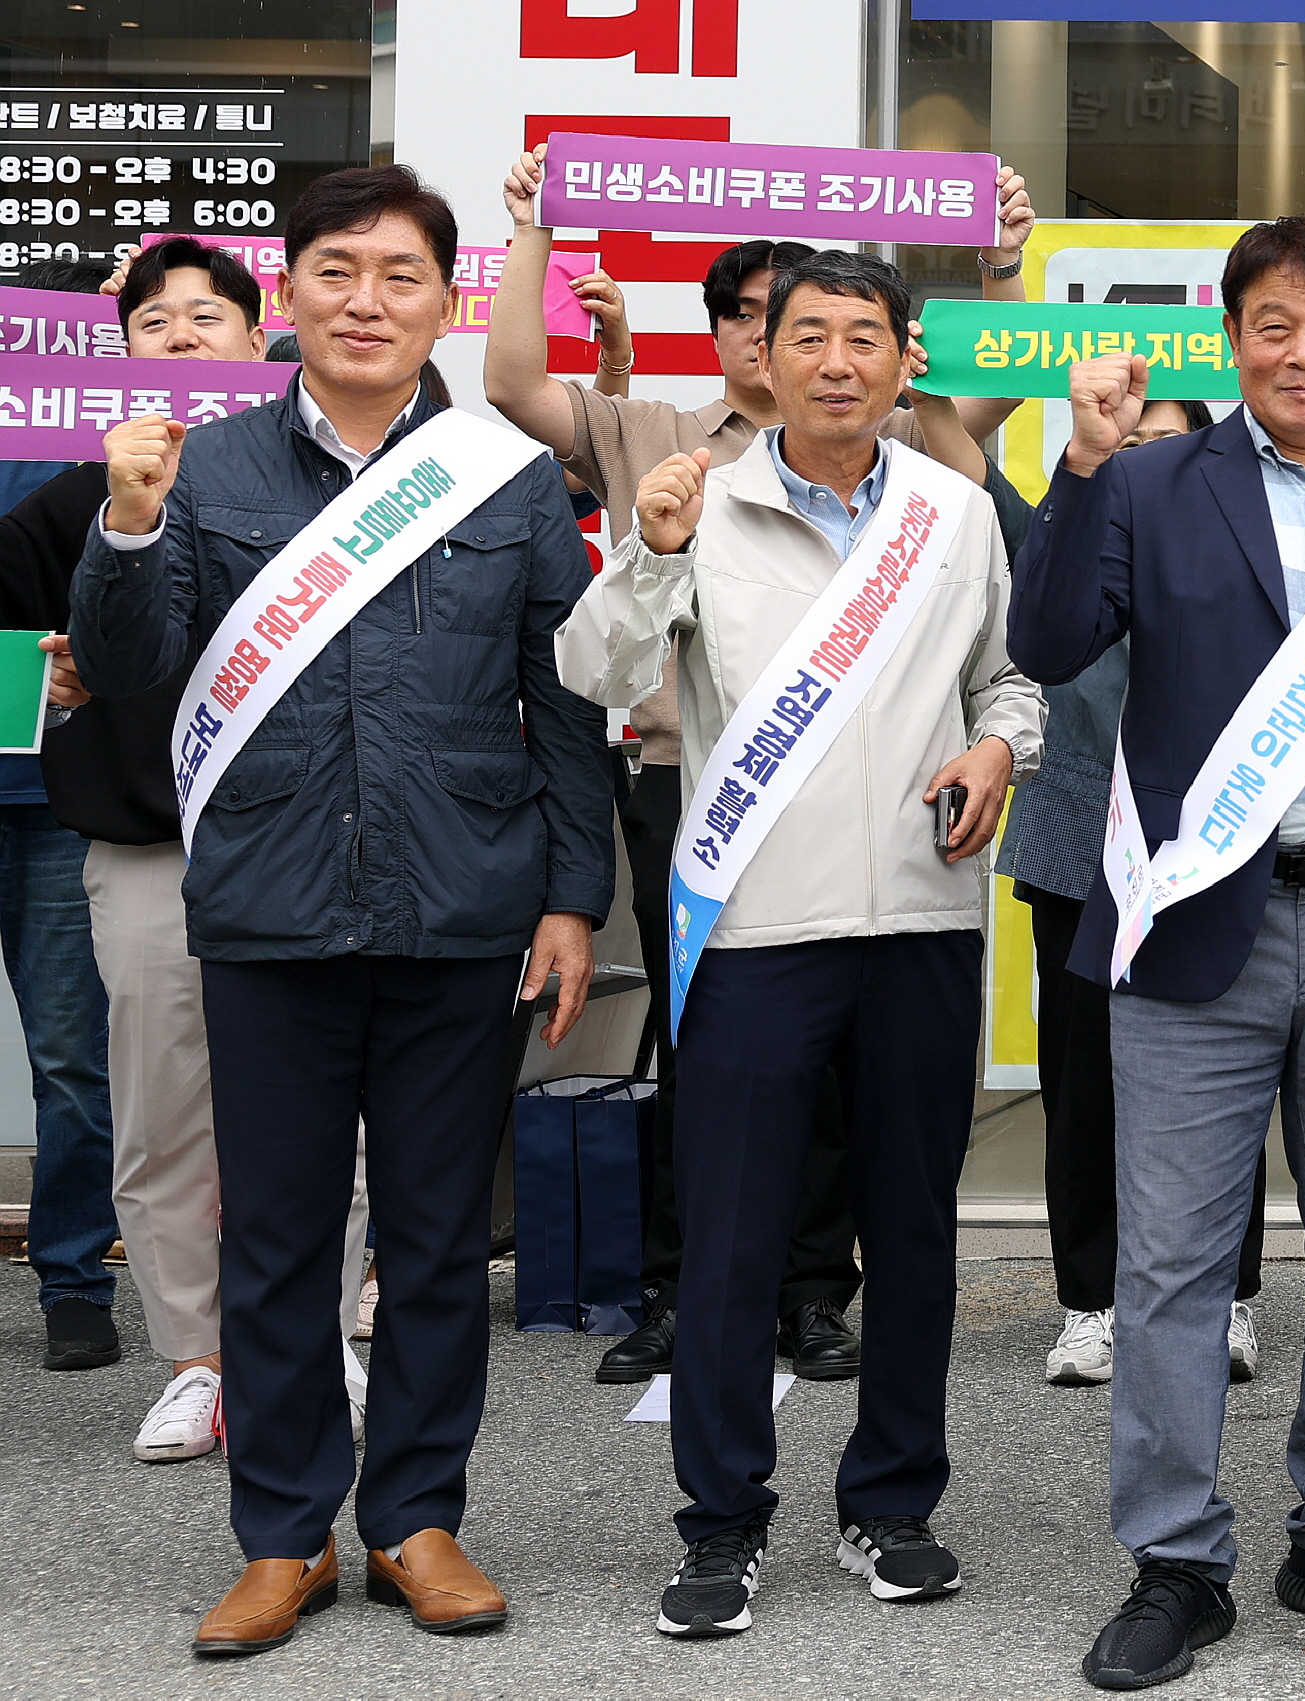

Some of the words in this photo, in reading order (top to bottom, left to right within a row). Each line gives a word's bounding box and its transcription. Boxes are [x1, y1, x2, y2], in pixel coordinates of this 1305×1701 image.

[69, 103, 186, 131] 보철치료
[215, 104, 272, 131] 틀니
[0, 156, 81, 184] 8:30
[115, 156, 171, 184] 오후
[192, 157, 276, 185] 4:30
[0, 198, 80, 226] 8:30
[114, 199, 170, 227] 오후
[194, 200, 276, 227] 6:00
[565, 161, 805, 210] 민생소비쿠폰
[817, 174, 974, 217] 조기사용
[0, 316, 128, 357] 기사용
[332, 455, 456, 564] 풍요롭고
[252, 550, 353, 651] 즐거운
[810, 490, 938, 682] 강진사랑상품권은
[209, 637, 271, 714] 명절
[732, 668, 832, 787] 지역경제
[692, 776, 758, 870] 활력소
[1199, 763, 1267, 854] 웃는다
